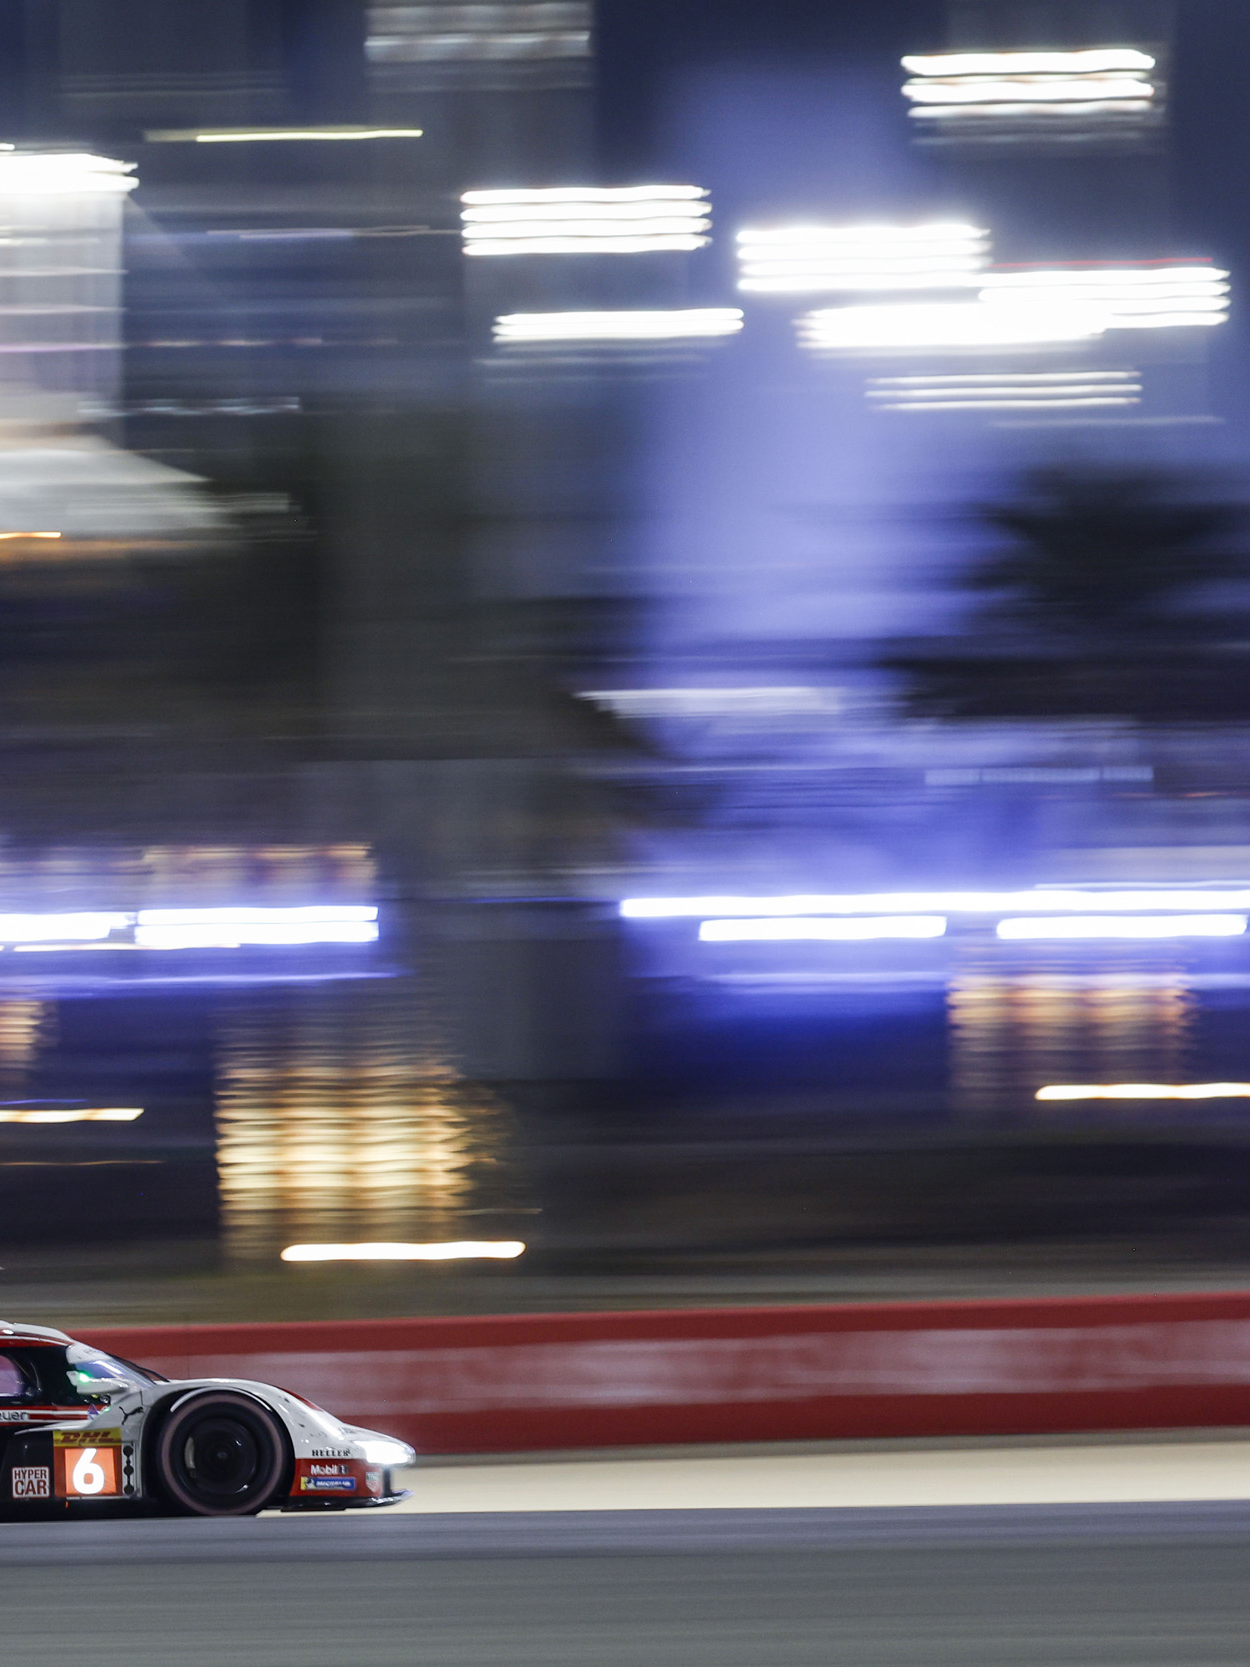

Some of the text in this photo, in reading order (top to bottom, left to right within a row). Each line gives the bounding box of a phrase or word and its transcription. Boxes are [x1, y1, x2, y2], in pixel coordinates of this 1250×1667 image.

[61, 1432, 112, 1442] DHL
[14, 1469, 47, 1479] HYPER
[73, 1448, 104, 1494] 6
[311, 1465, 337, 1475] Mobil
[15, 1480, 47, 1495] CAR
